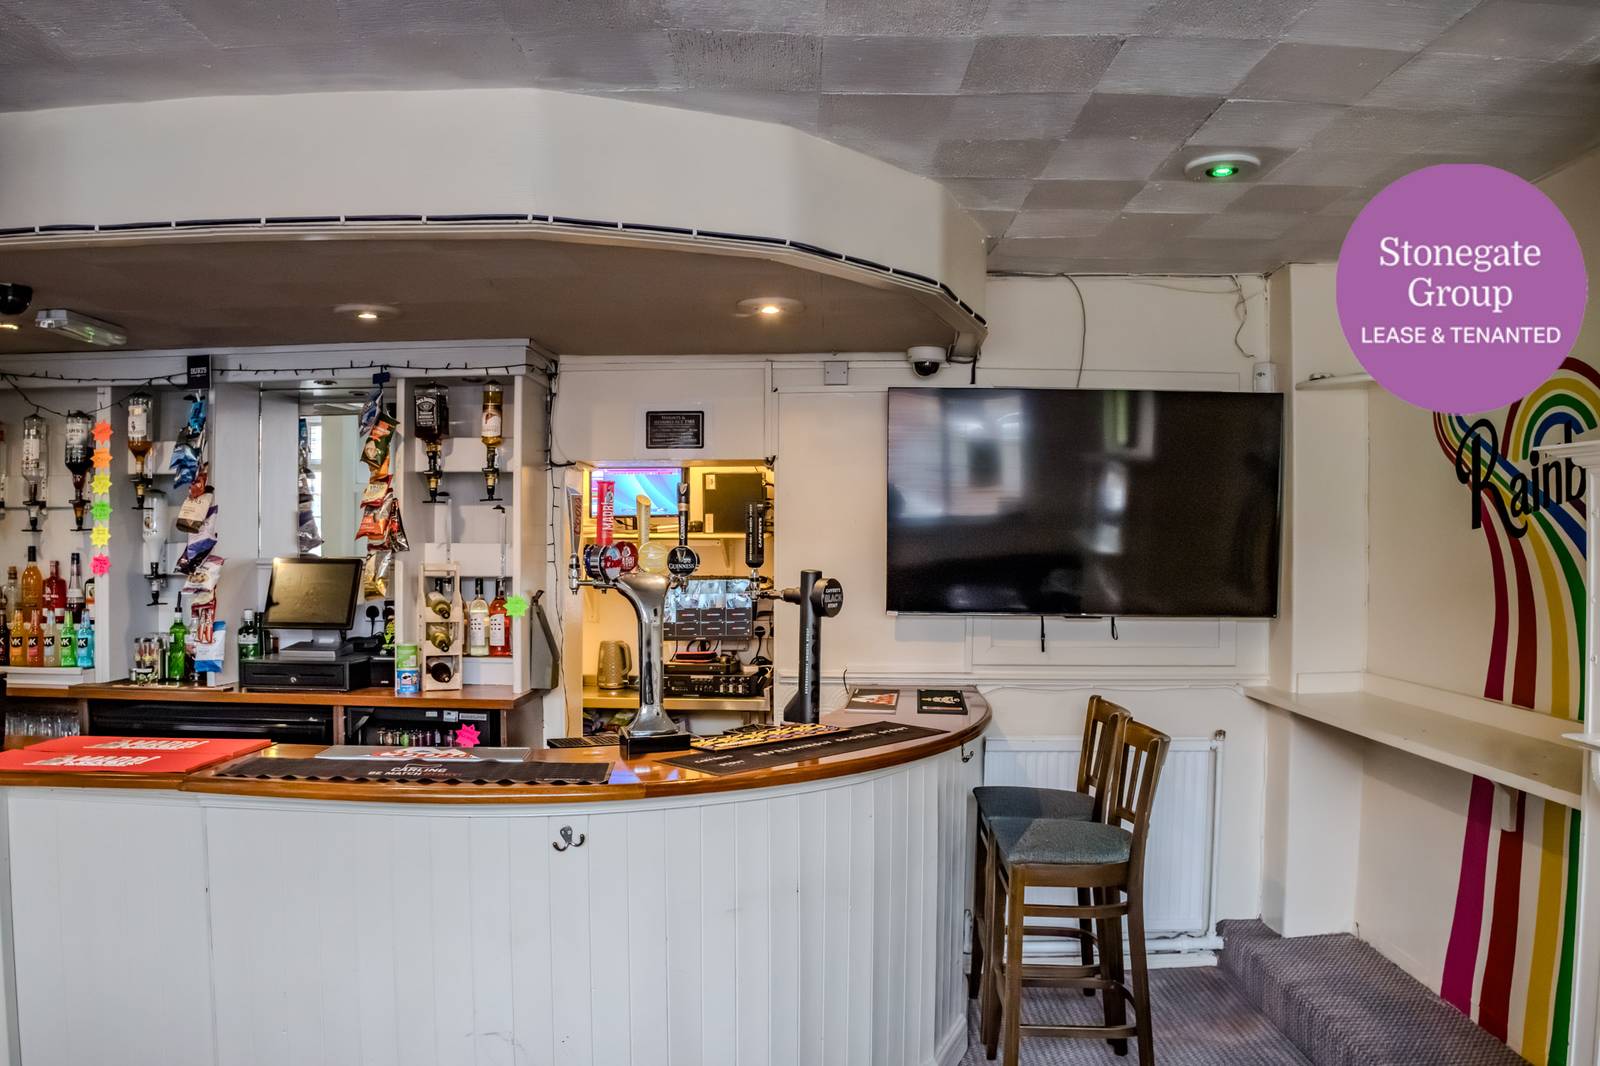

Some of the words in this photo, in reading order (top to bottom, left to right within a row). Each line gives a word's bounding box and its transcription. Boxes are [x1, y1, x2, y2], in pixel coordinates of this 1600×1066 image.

[668, 562, 695, 571] GUINNESS
[824, 594, 842, 603] BLACK
[11, 638, 22, 646] VK
[390, 765, 449, 773] CARLING
